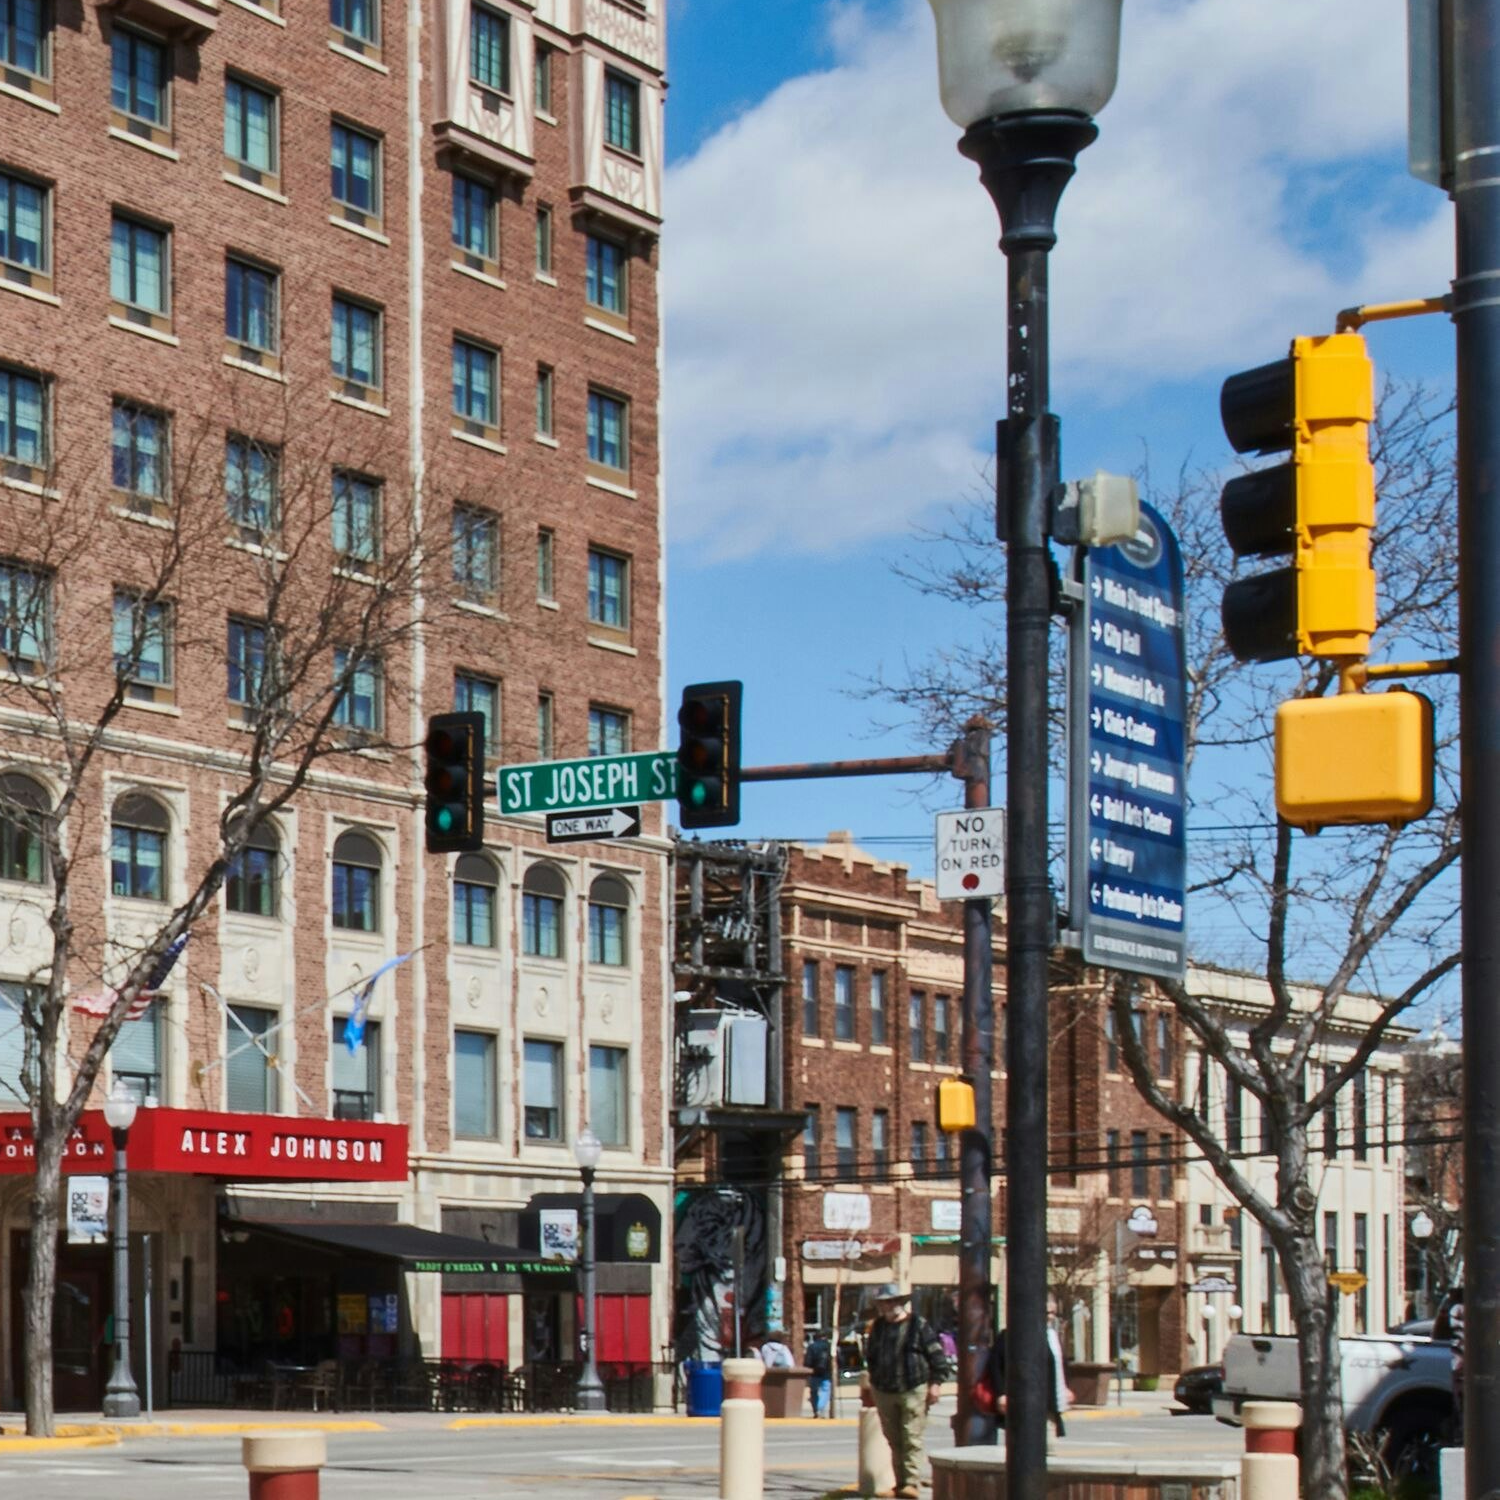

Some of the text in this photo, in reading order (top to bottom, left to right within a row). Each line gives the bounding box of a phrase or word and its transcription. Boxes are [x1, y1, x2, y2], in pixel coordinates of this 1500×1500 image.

[507, 758, 678, 809] ST JOSEPH ST
[555, 817, 611, 835] ONE WAY
[956, 817, 984, 834] NO
[950, 838, 991, 853] TURN
[941, 854, 1000, 871] ON RED
[11, 1127, 83, 1141] AX
[181, 1129, 383, 1163] ALEX JOHNSON
